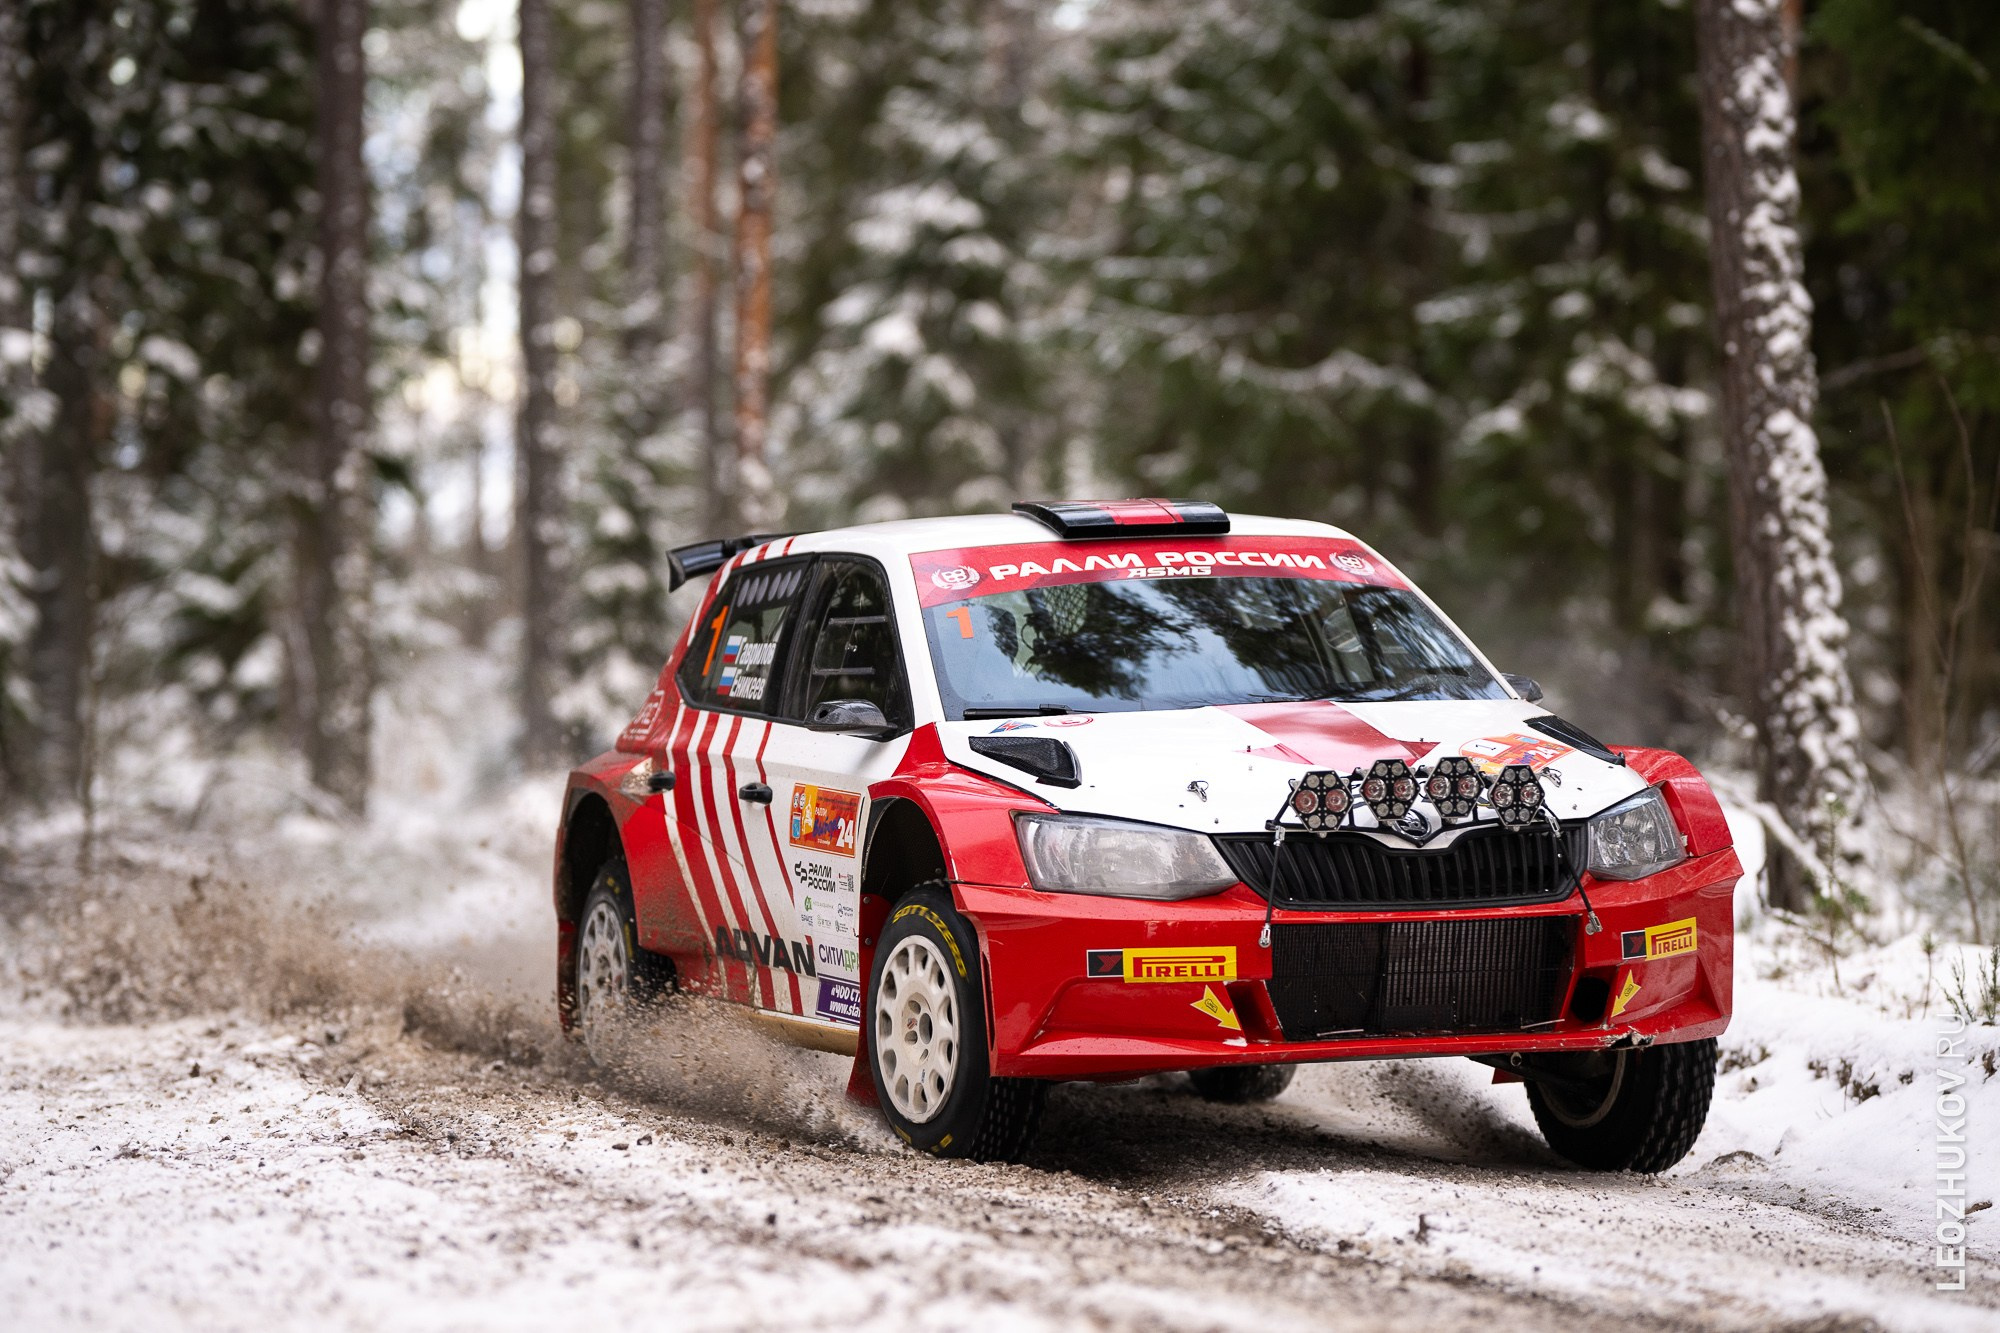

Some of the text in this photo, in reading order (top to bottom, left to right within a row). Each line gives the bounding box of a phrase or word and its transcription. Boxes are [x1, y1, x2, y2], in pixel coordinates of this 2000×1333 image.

[989, 551, 1327, 581] РАЛЛИ РОССИИ
[946, 606, 975, 639] 1
[702, 605, 729, 676] 1
[836, 817, 854, 849] 24
[808, 862, 832, 878] РАЛЛИ
[808, 876, 836, 893] РОССИИ
[716, 925, 817, 978] ADVAN
[1651, 926, 1693, 956] PIRELLI
[1133, 955, 1227, 977] PIRELLI
